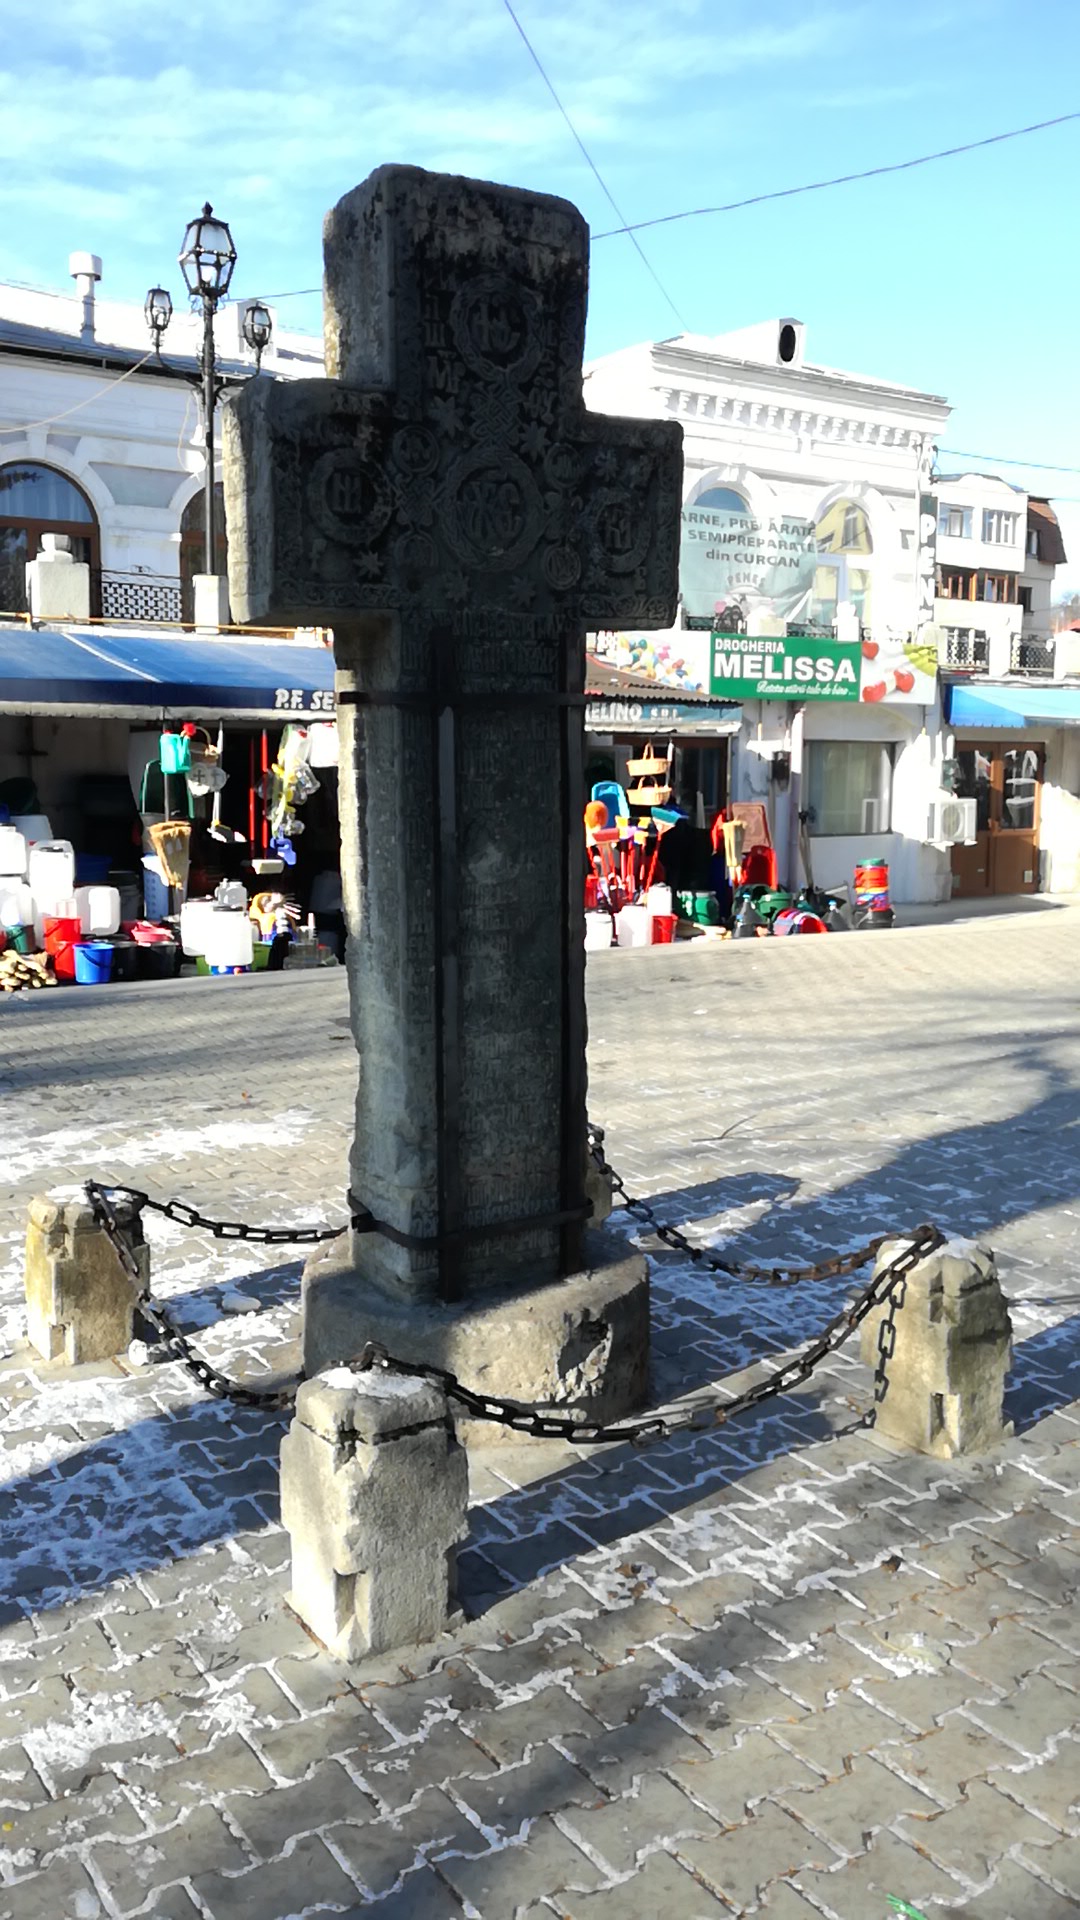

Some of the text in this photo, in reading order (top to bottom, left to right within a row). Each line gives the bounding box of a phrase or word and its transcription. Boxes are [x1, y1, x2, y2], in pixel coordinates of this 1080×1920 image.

[729, 517, 816, 538] PREARATE
[688, 529, 816, 553] SEMIPREPARATE
[706, 548, 800, 568] din CURCAN
[714, 637, 785, 654] DROGHERIA
[714, 653, 857, 682] MELISSA
[310, 690, 337, 711] SE
[585, 702, 643, 721] ELINO
